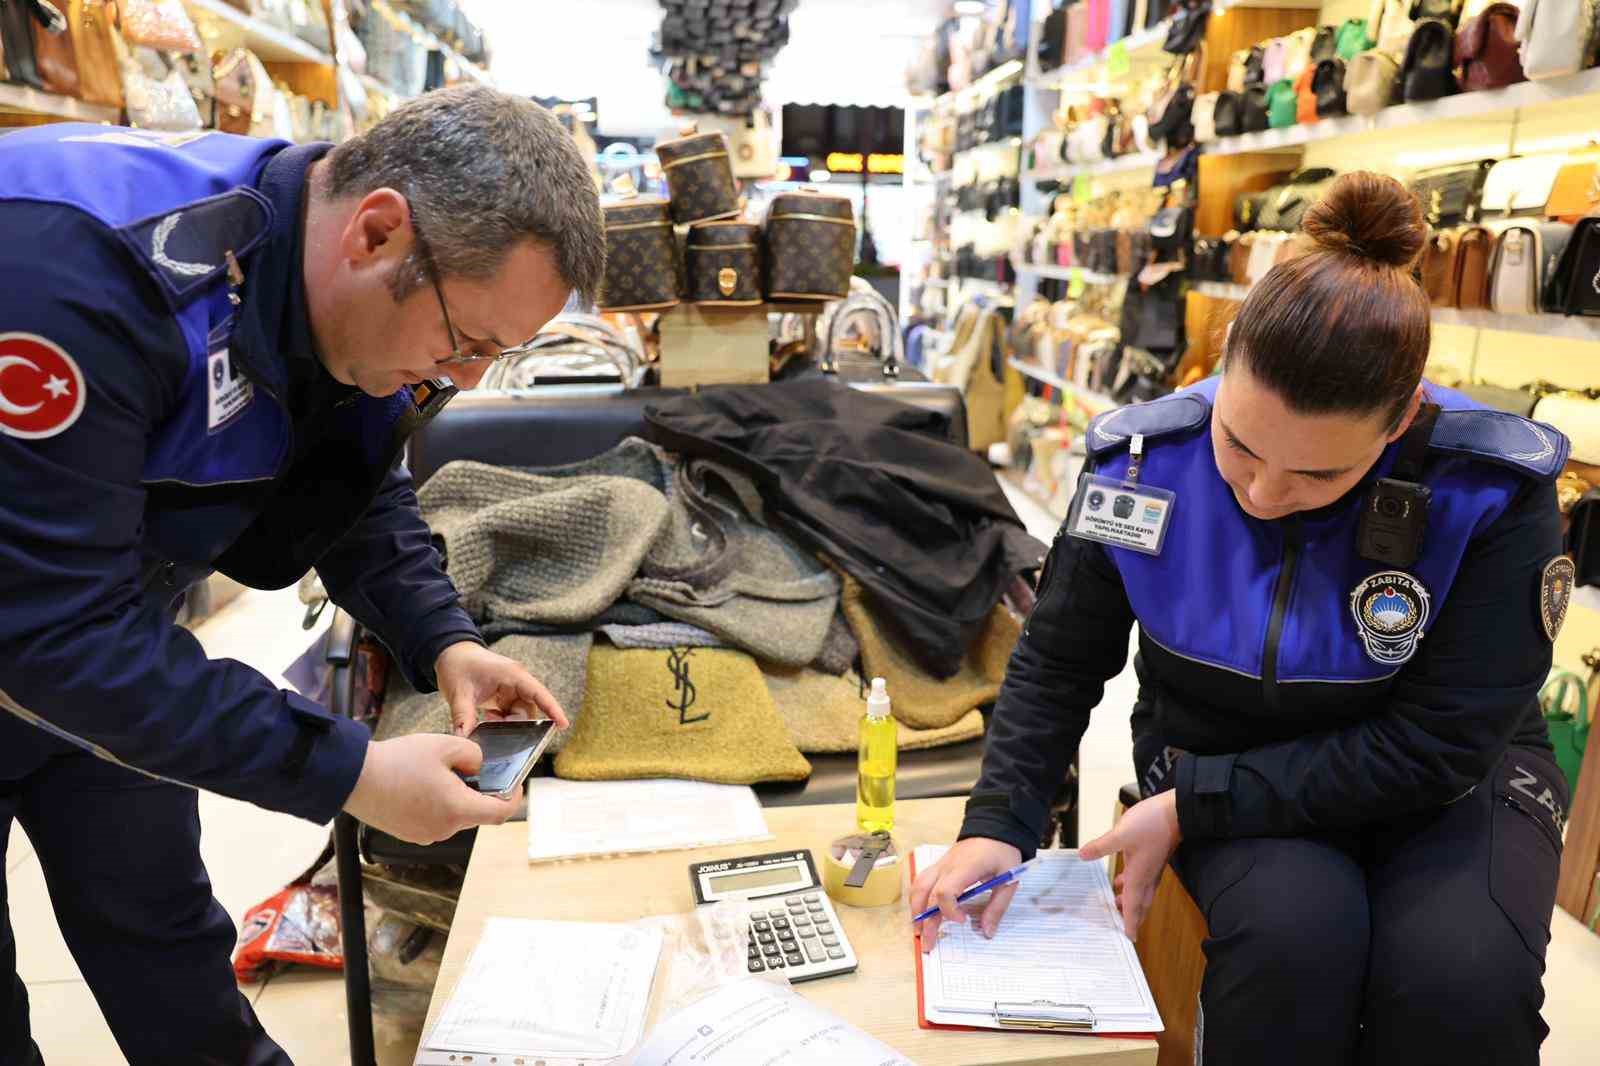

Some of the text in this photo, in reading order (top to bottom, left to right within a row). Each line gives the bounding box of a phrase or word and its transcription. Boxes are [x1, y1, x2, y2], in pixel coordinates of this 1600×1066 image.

[1369, 576, 1411, 588] ZABITA
[666, 647, 711, 725] YSL
[697, 863, 729, 874] JOINUS
